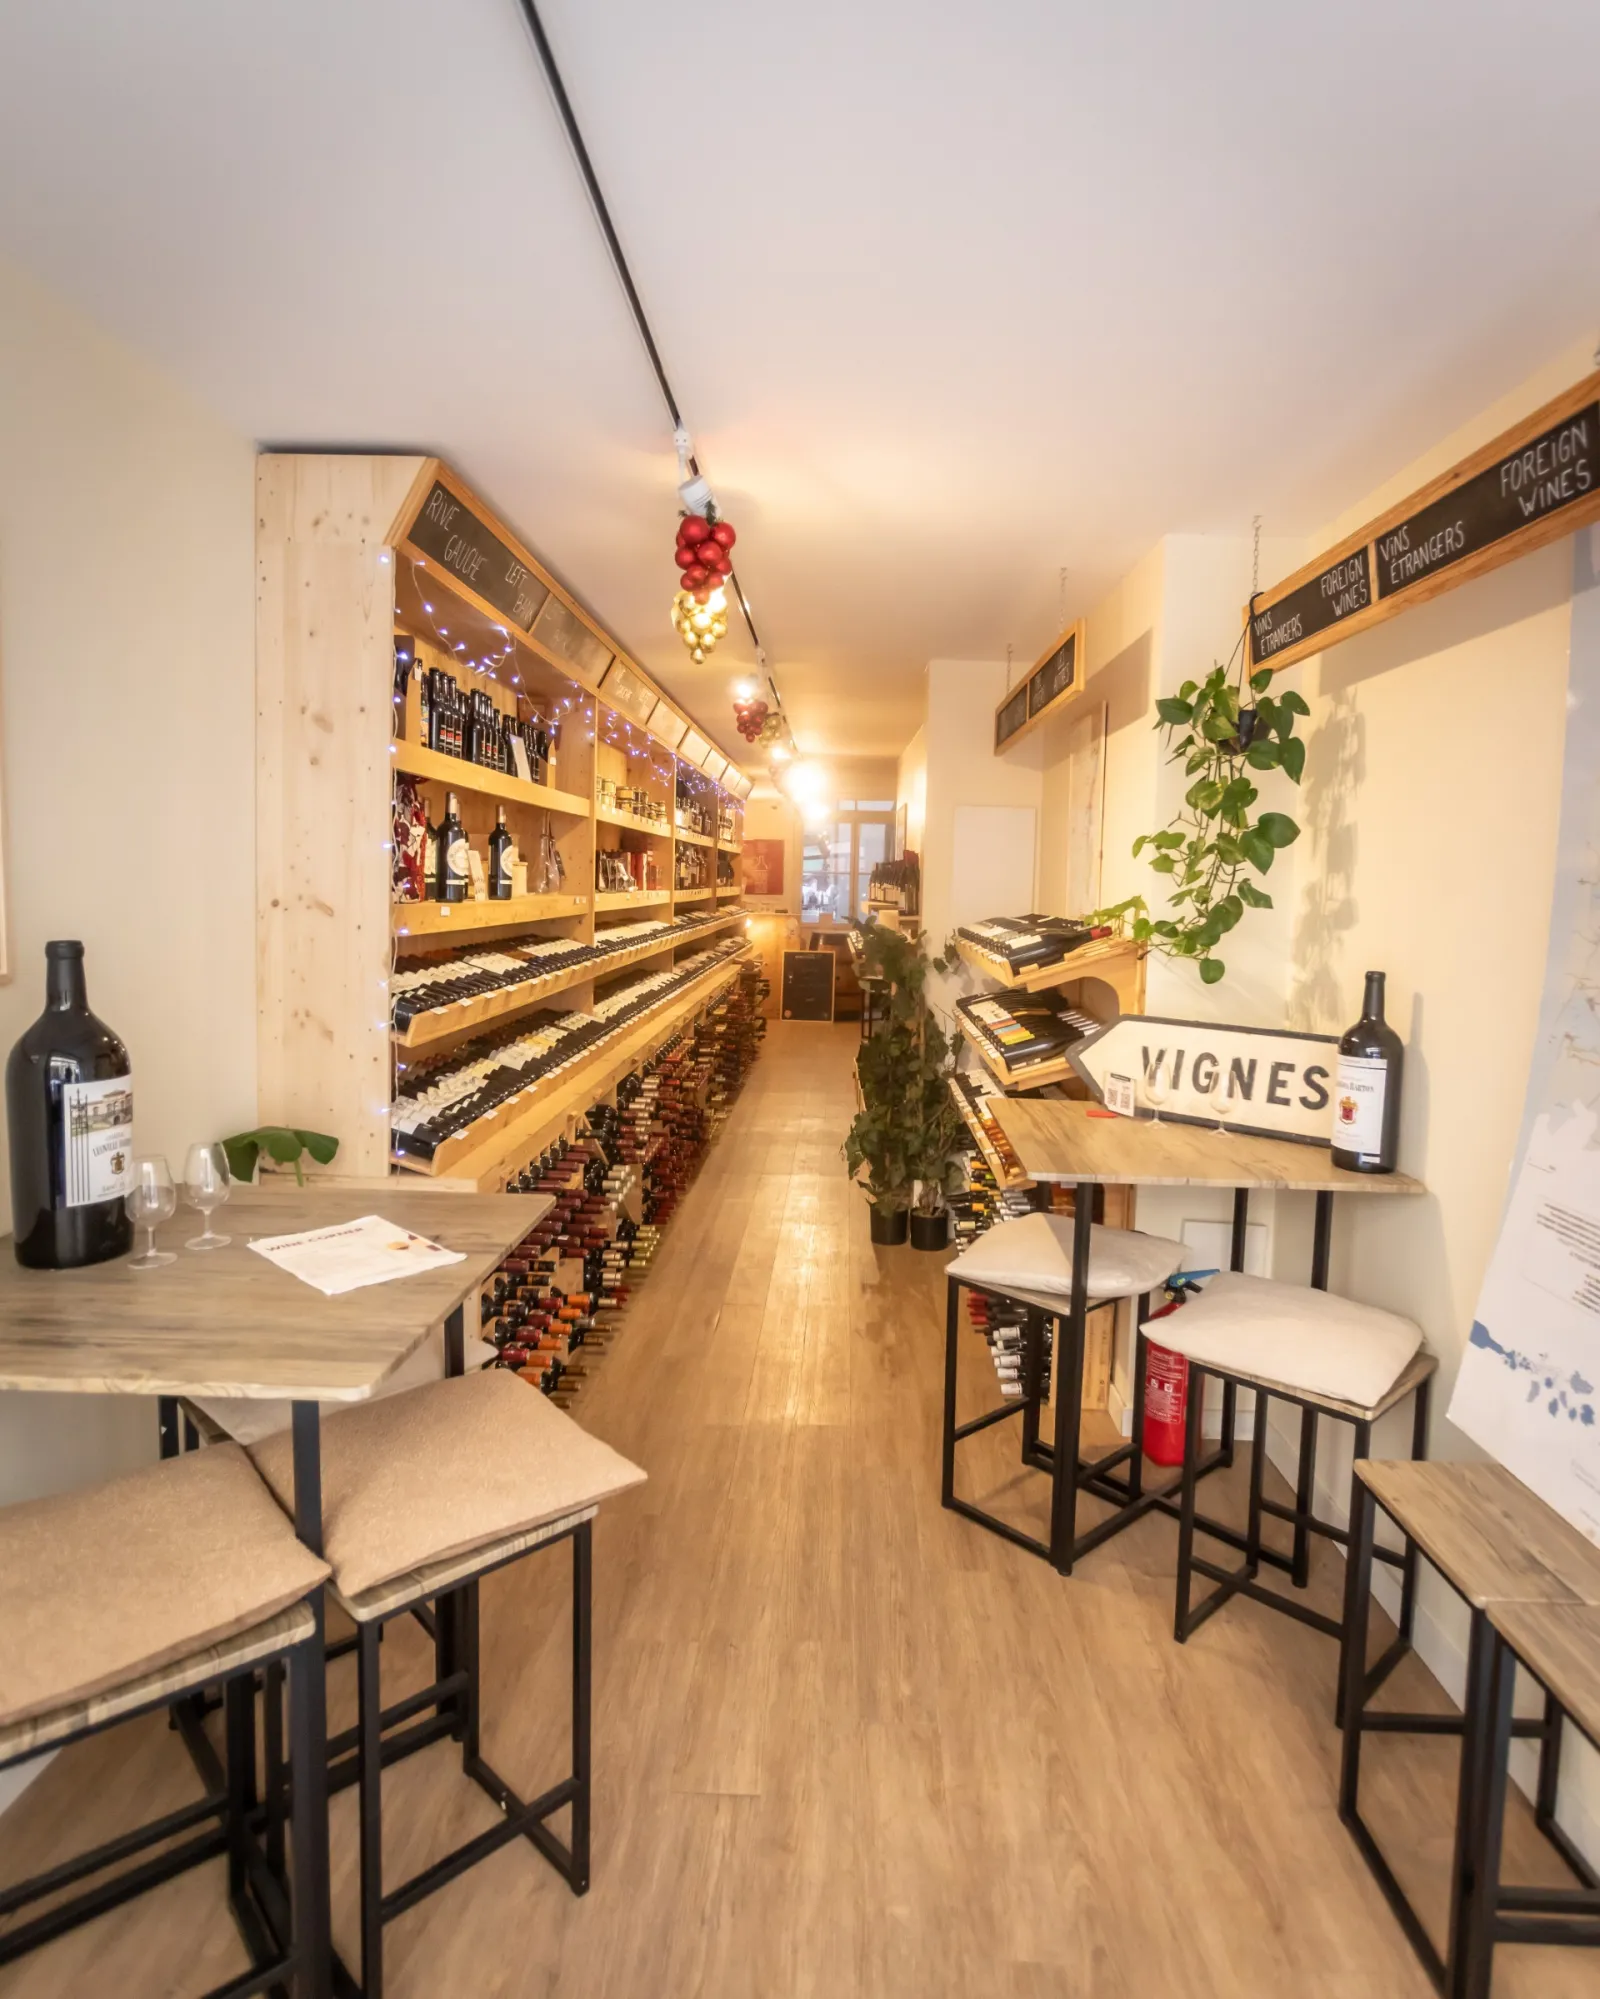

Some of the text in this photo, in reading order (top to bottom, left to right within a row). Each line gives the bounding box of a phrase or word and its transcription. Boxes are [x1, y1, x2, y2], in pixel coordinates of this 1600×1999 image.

[443, 534, 488, 581] GAUCHE
[505, 561, 528, 589] LEFT
[1390, 521, 1465, 585] ÉTRANGERS
[1141, 1045, 1331, 1111] VIGNES
[266, 1227, 364, 1252] WINE CORNER
